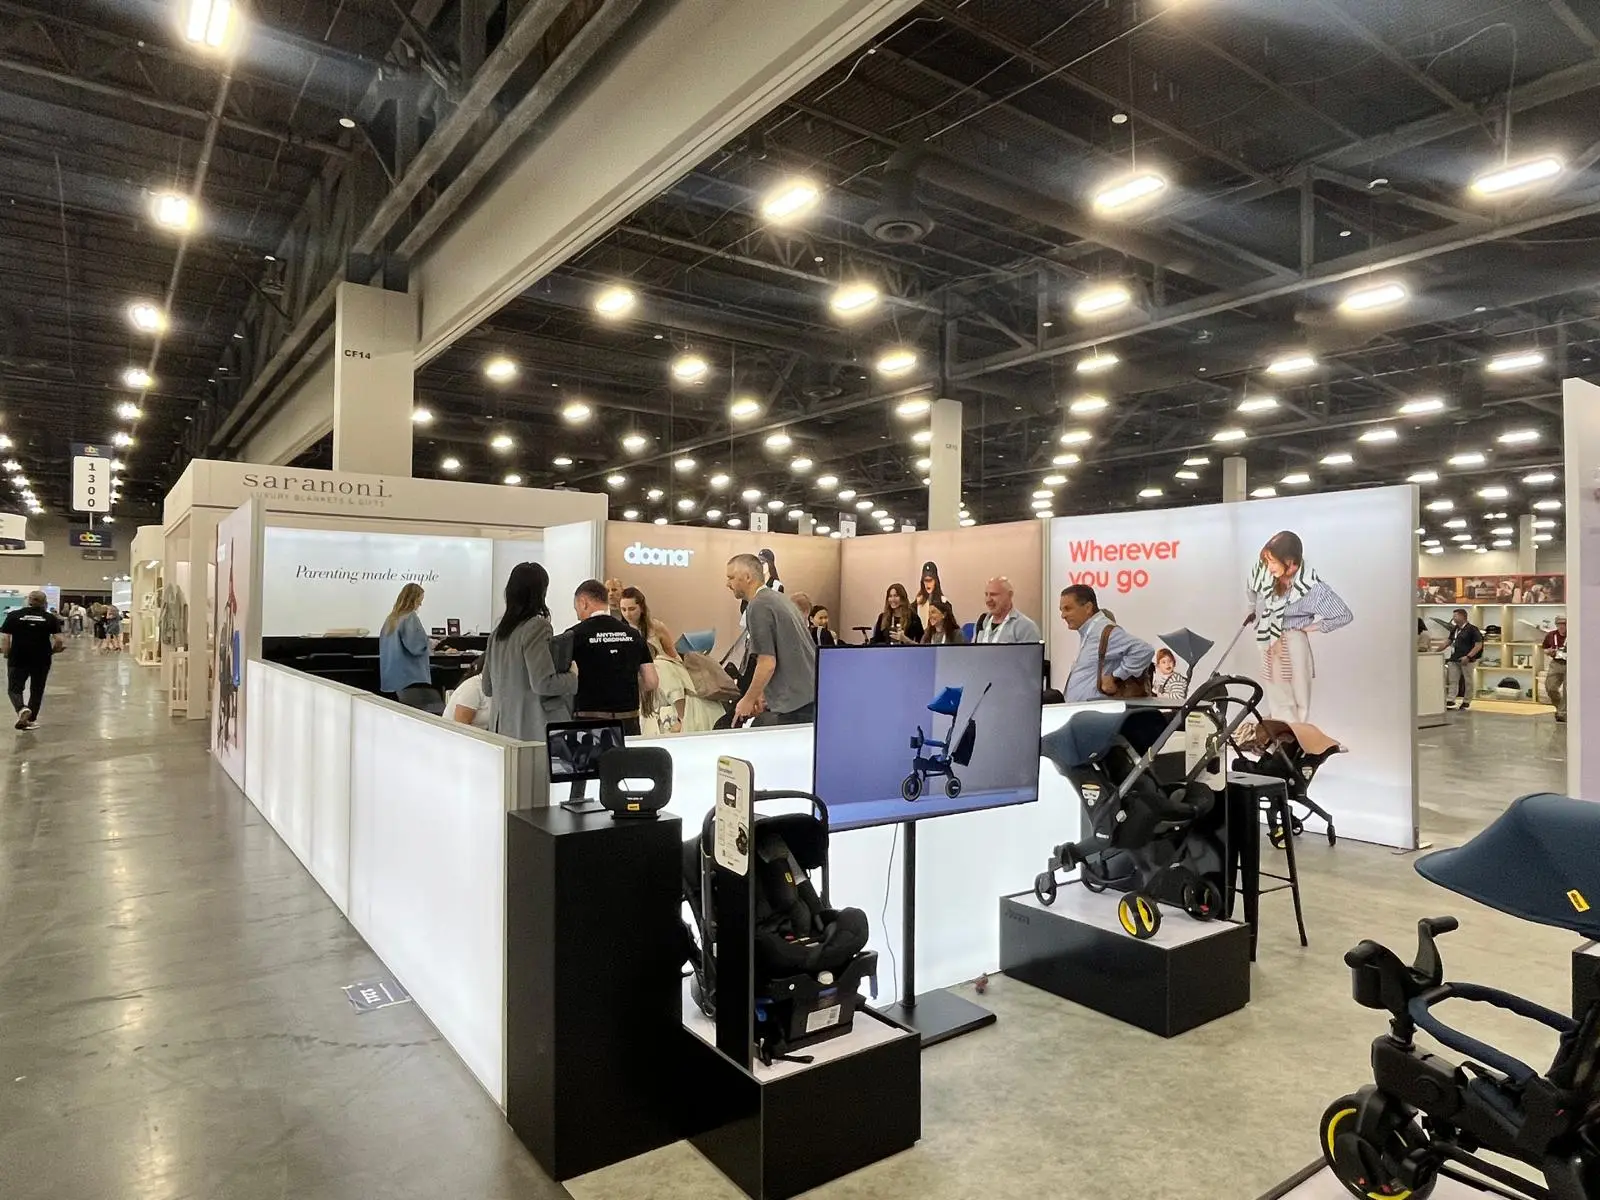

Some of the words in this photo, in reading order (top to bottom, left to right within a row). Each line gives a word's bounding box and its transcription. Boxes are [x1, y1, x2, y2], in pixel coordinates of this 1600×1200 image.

[344, 349, 371, 360] CF14
[243, 473, 388, 498] saranoni
[1069, 540, 1180, 562] Wherever
[296, 565, 359, 584] Parenting
[361, 568, 398, 581] made
[400, 568, 440, 585] simple
[1069, 570, 1109, 588] you
[1117, 569, 1149, 593] go
